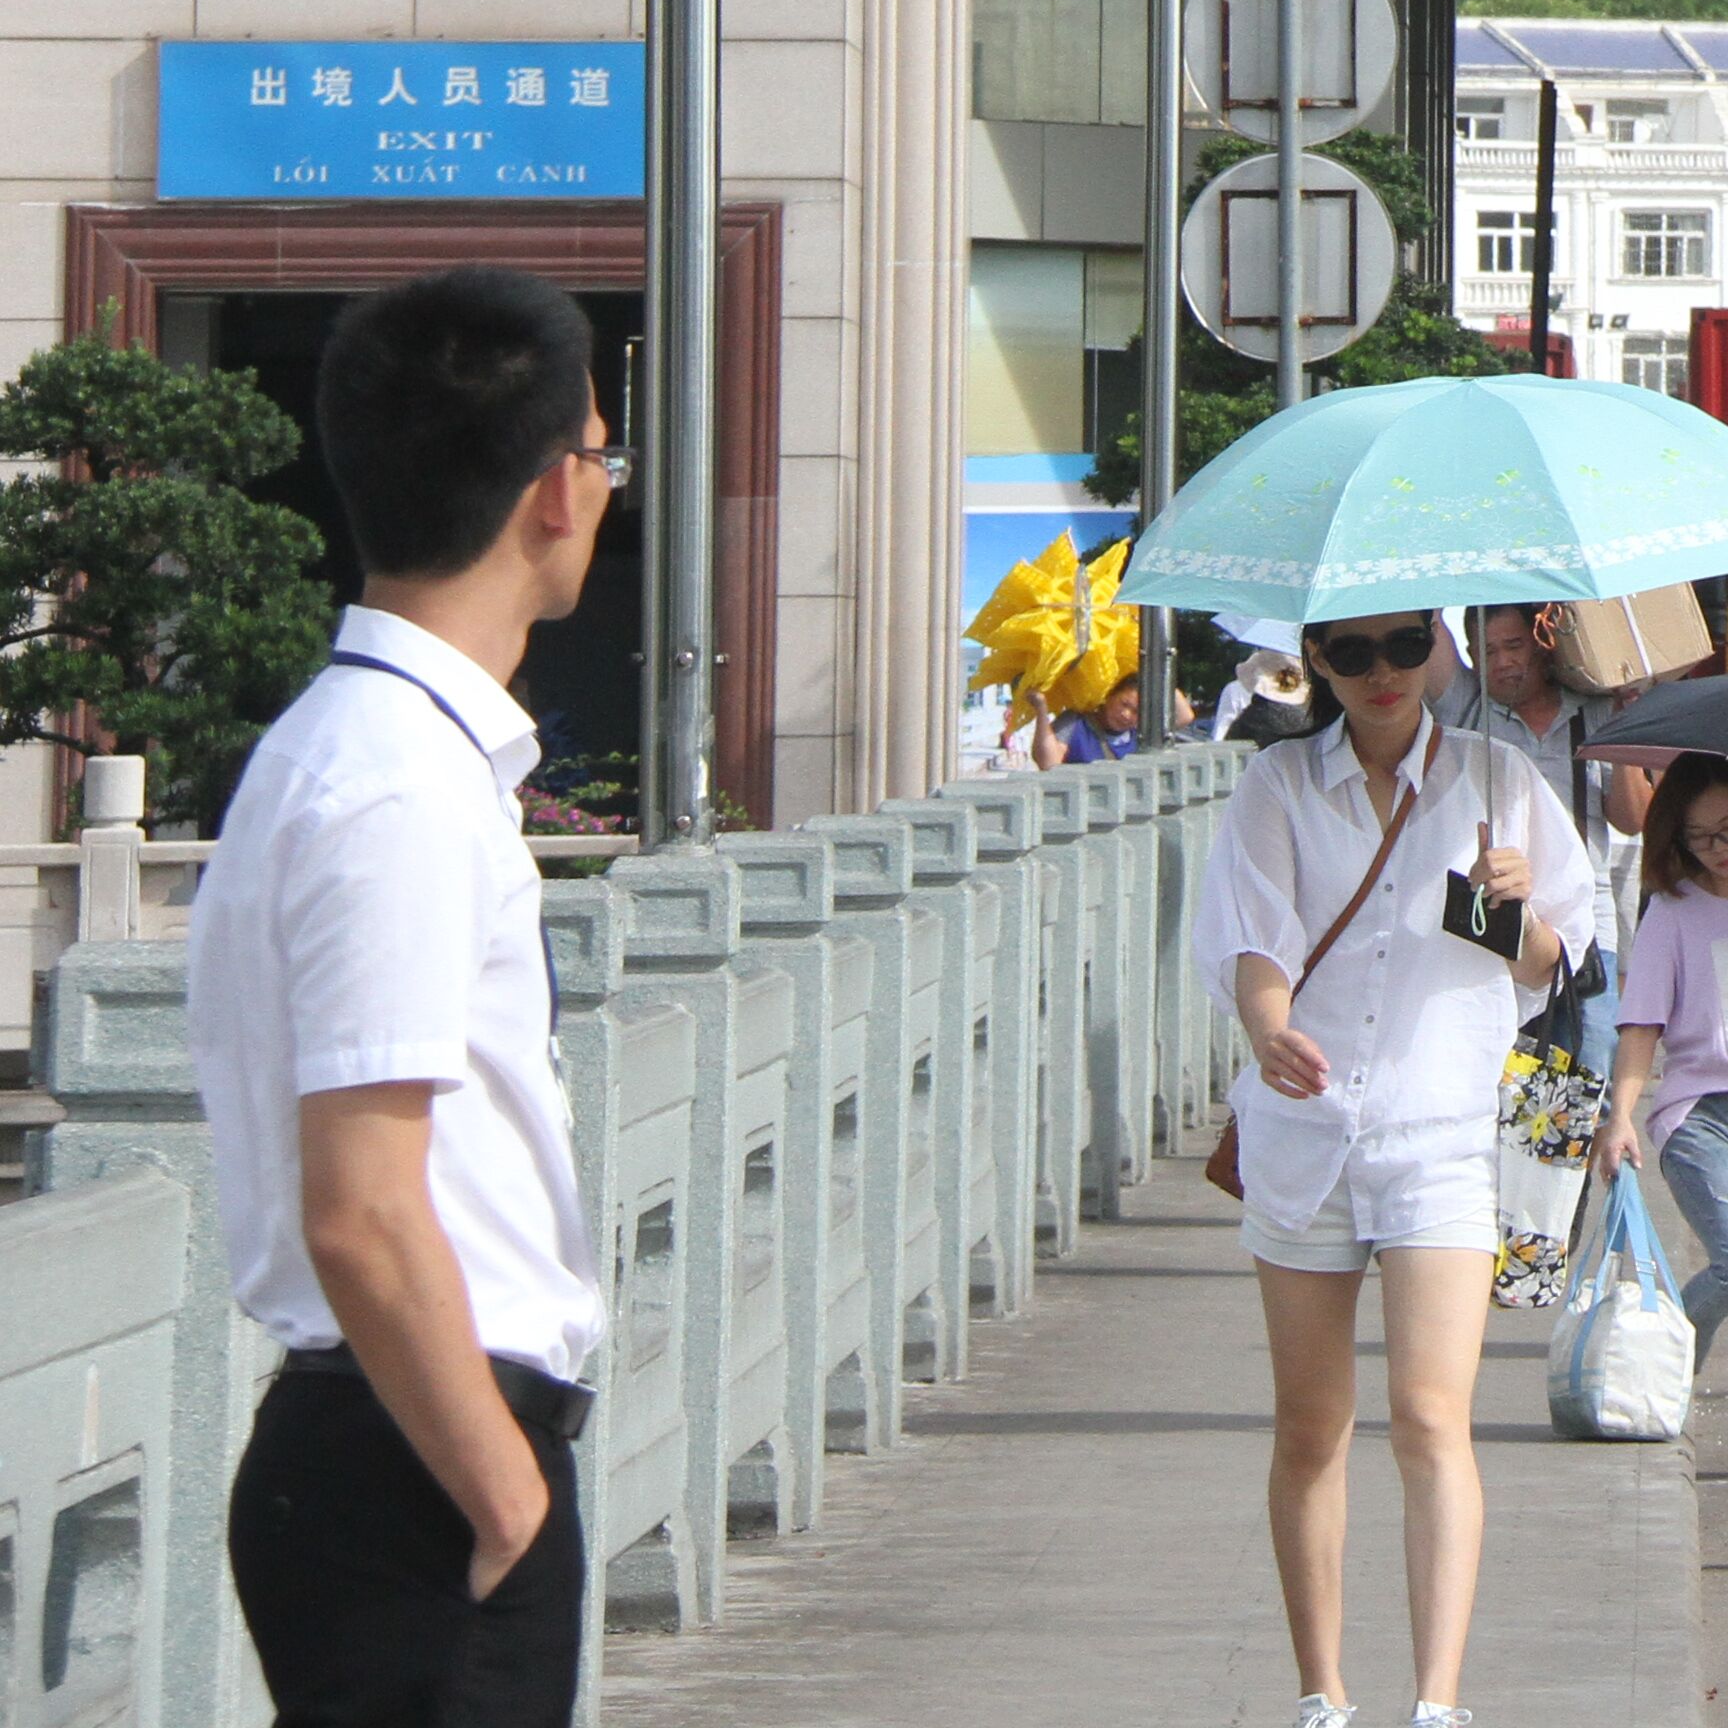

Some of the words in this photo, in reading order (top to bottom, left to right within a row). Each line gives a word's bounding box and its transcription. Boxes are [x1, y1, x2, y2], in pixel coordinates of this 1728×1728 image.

[250, 67, 611, 108] 出境人员通道
[377, 131, 495, 151] EXIT
